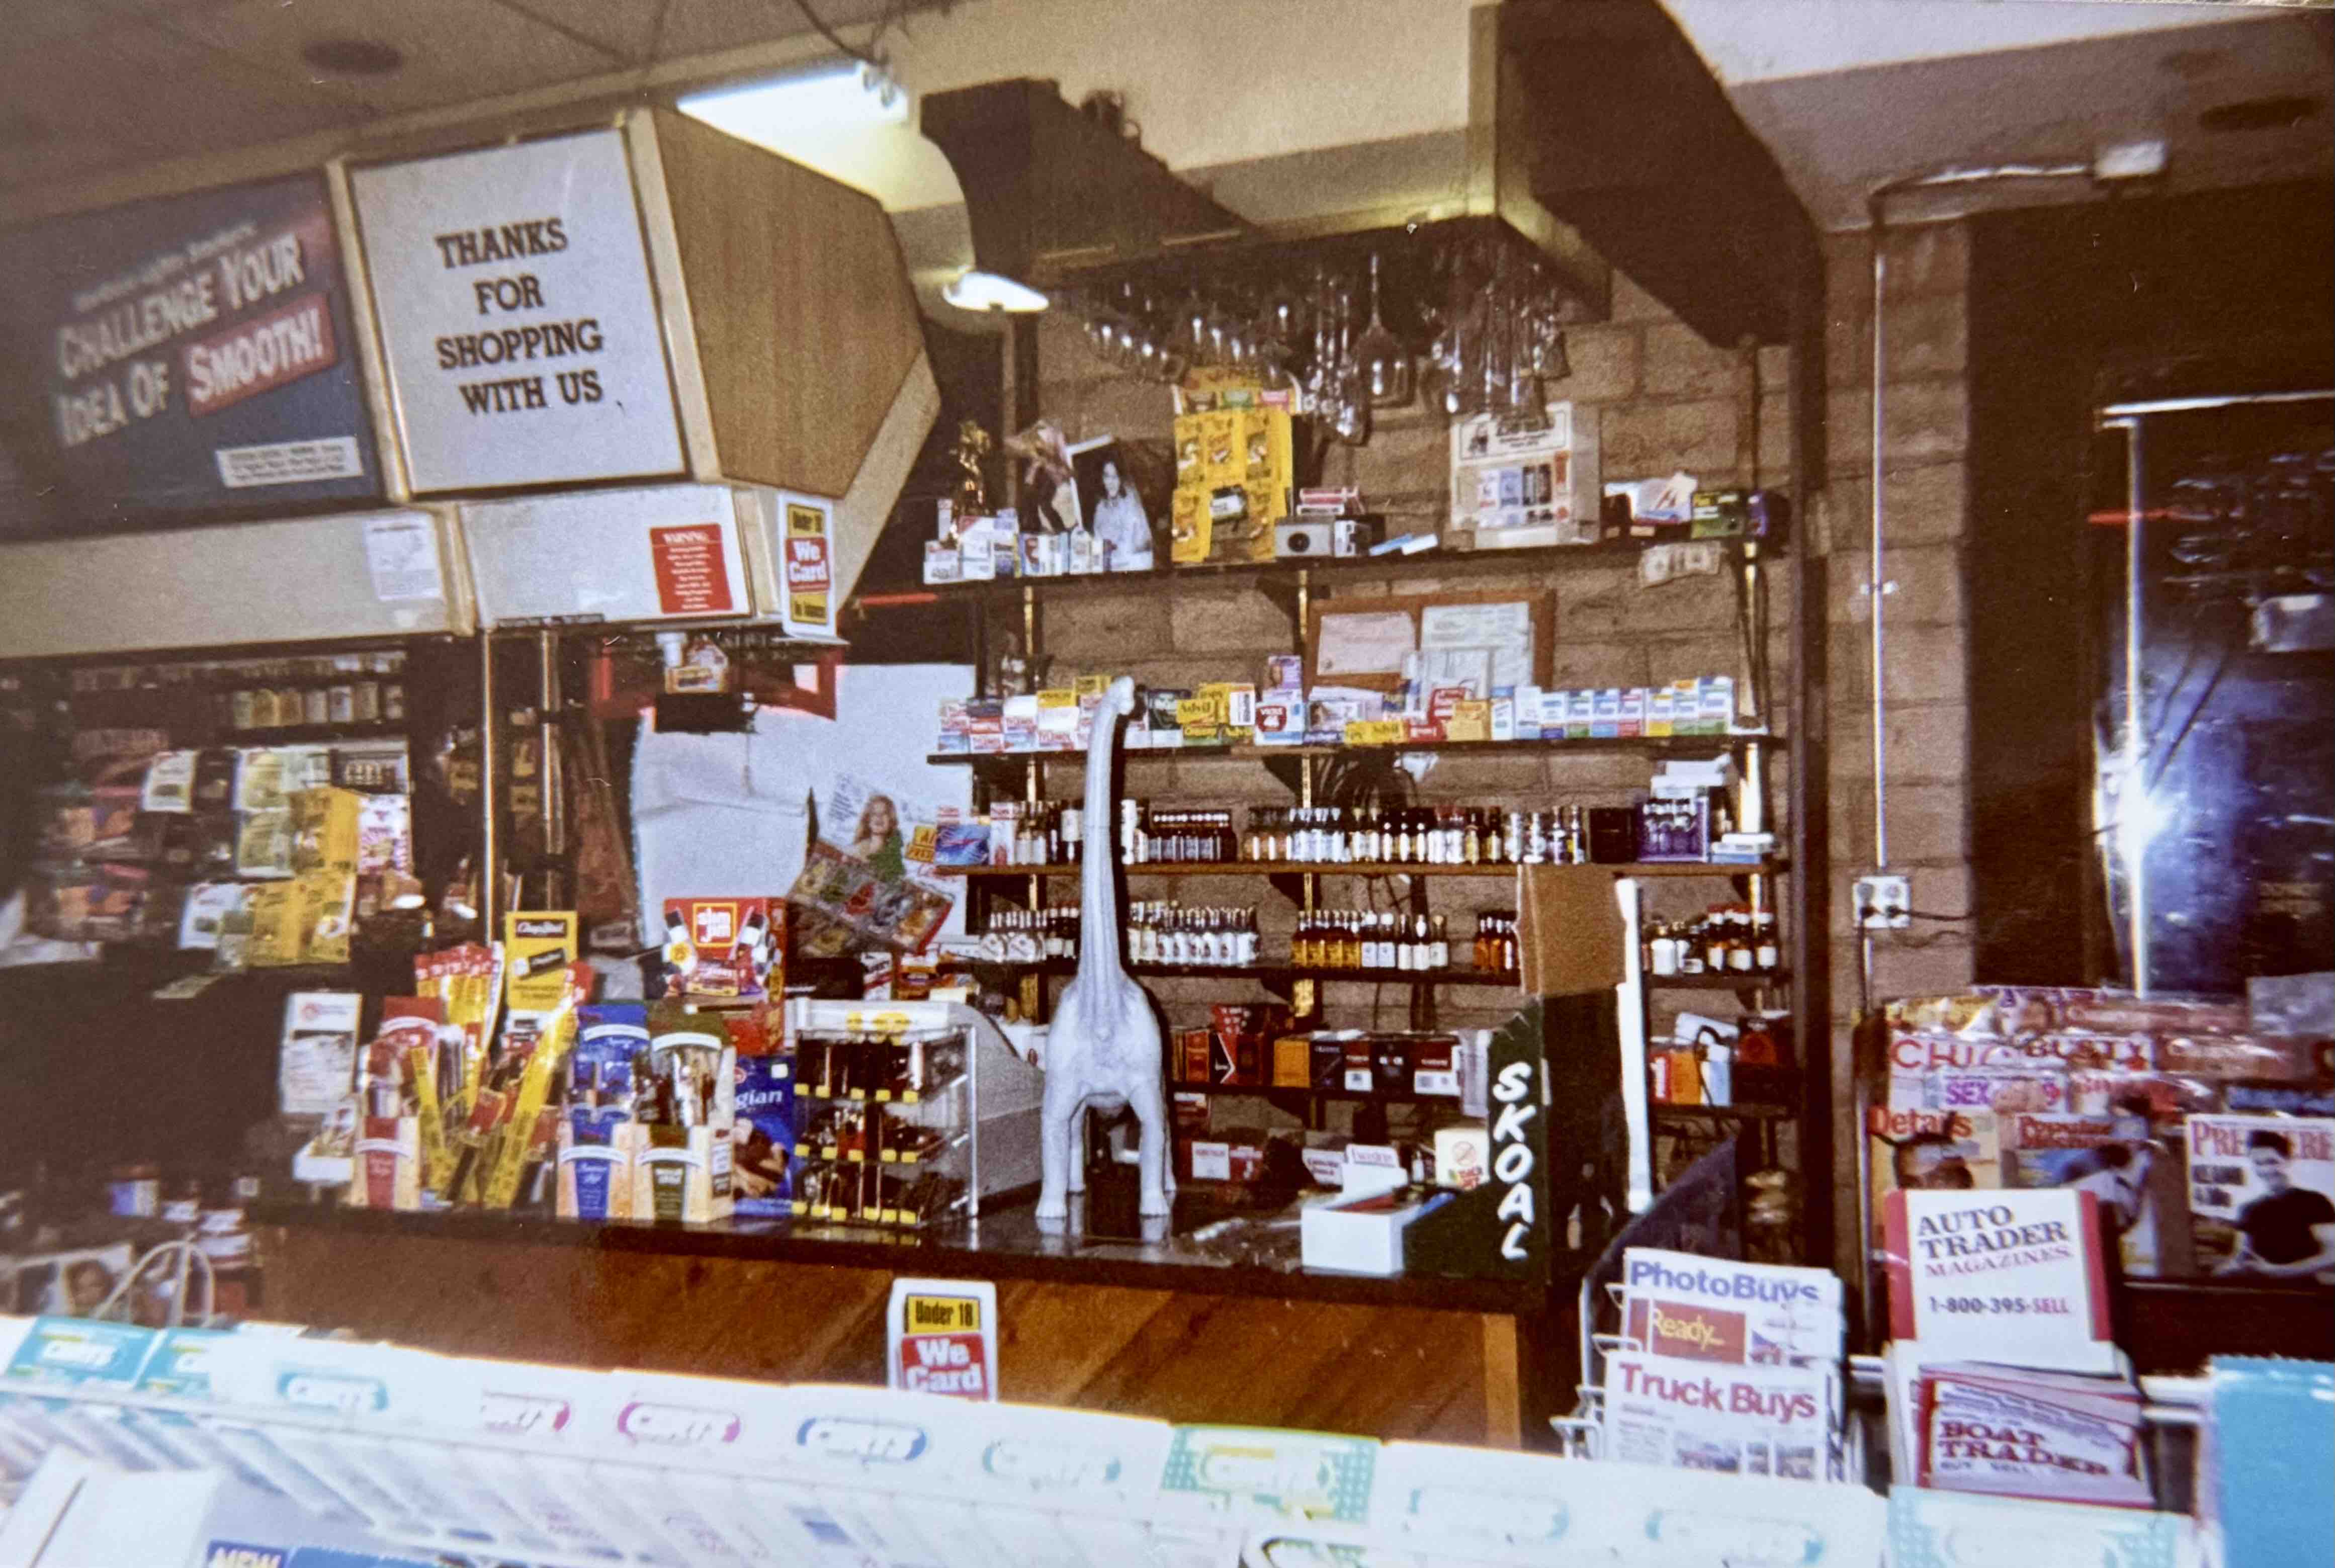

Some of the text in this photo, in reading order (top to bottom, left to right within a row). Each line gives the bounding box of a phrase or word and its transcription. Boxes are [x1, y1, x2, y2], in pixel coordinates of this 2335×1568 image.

[435, 218, 568, 269] THANKS
[58, 272, 217, 379] CHALLENGE
[218, 232, 305, 309] YOUR
[474, 274, 545, 314] FOR
[436, 318, 603, 370] SHOPPING
[129, 361, 169, 417] OF
[190, 308, 324, 402] SMOOTH!
[460, 369, 603, 415] WITH US
[794, 540, 821, 561] We
[734, 1089, 783, 1110] gian
[1946, 1081, 1990, 1105] SEX
[1493, 1061, 1536, 1261] SKOAL
[1918, 1205, 2017, 1237] AUTO
[1919, 1221, 2070, 1260] TRADER
[1925, 1247, 2073, 1278] MAGAZINES
[1630, 1260, 1820, 1302] PhotoBuys
[915, 1300, 973, 1327] Under 18
[1930, 1296, 2070, 1315] 1-800-395-SELL
[916, 1338, 970, 1367] We
[907, 1363, 982, 1393] Card
[1619, 1362, 1817, 1424] Truck Buys
[1939, 1421, 2046, 1445] BOAT
[1938, 1439, 2110, 1475] TRADER
